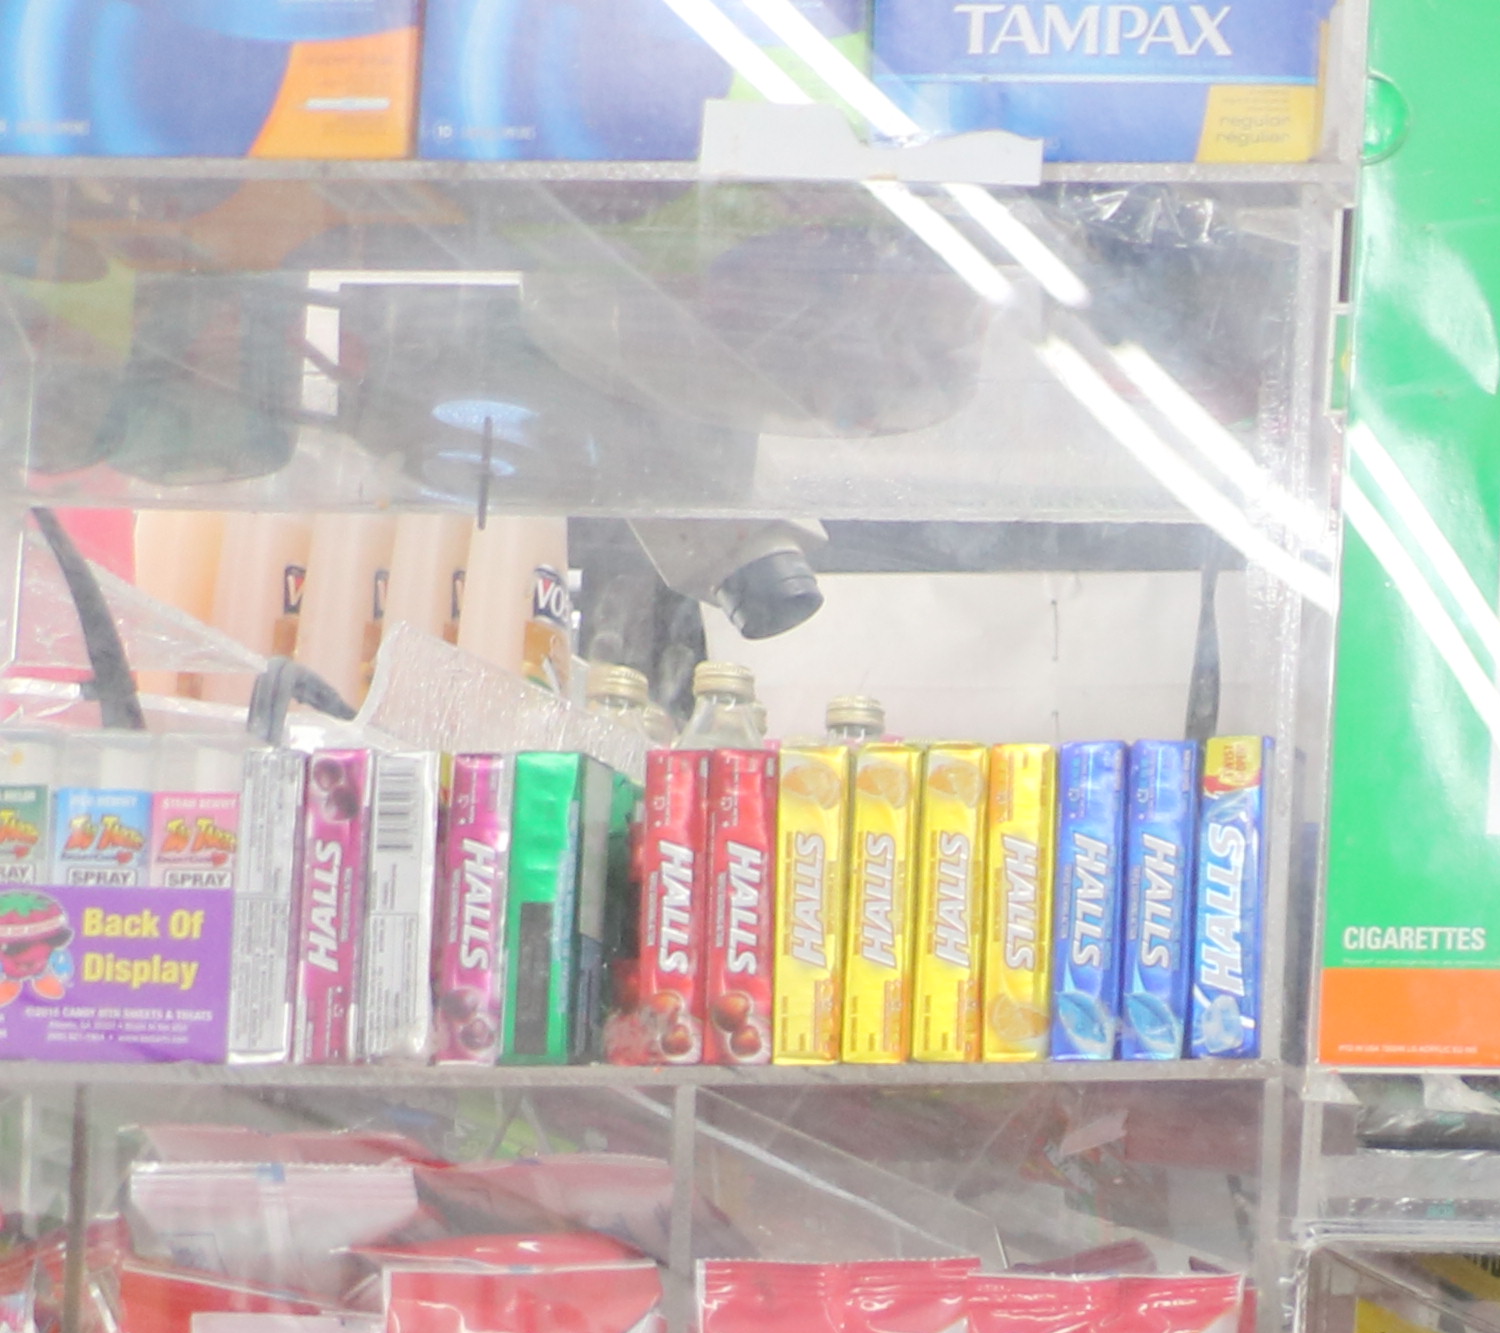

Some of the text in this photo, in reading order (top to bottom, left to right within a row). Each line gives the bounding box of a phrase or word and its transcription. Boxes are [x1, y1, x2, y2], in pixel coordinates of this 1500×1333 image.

[953, 2, 1232, 57] TAMPAX
[83, 909, 204, 939] Back Of
[308, 840, 342, 972] HALLS
[1200, 822, 1245, 999] HALLS
[1342, 926, 1487, 952] CIGARETTES
[83, 955, 199, 990] Display
